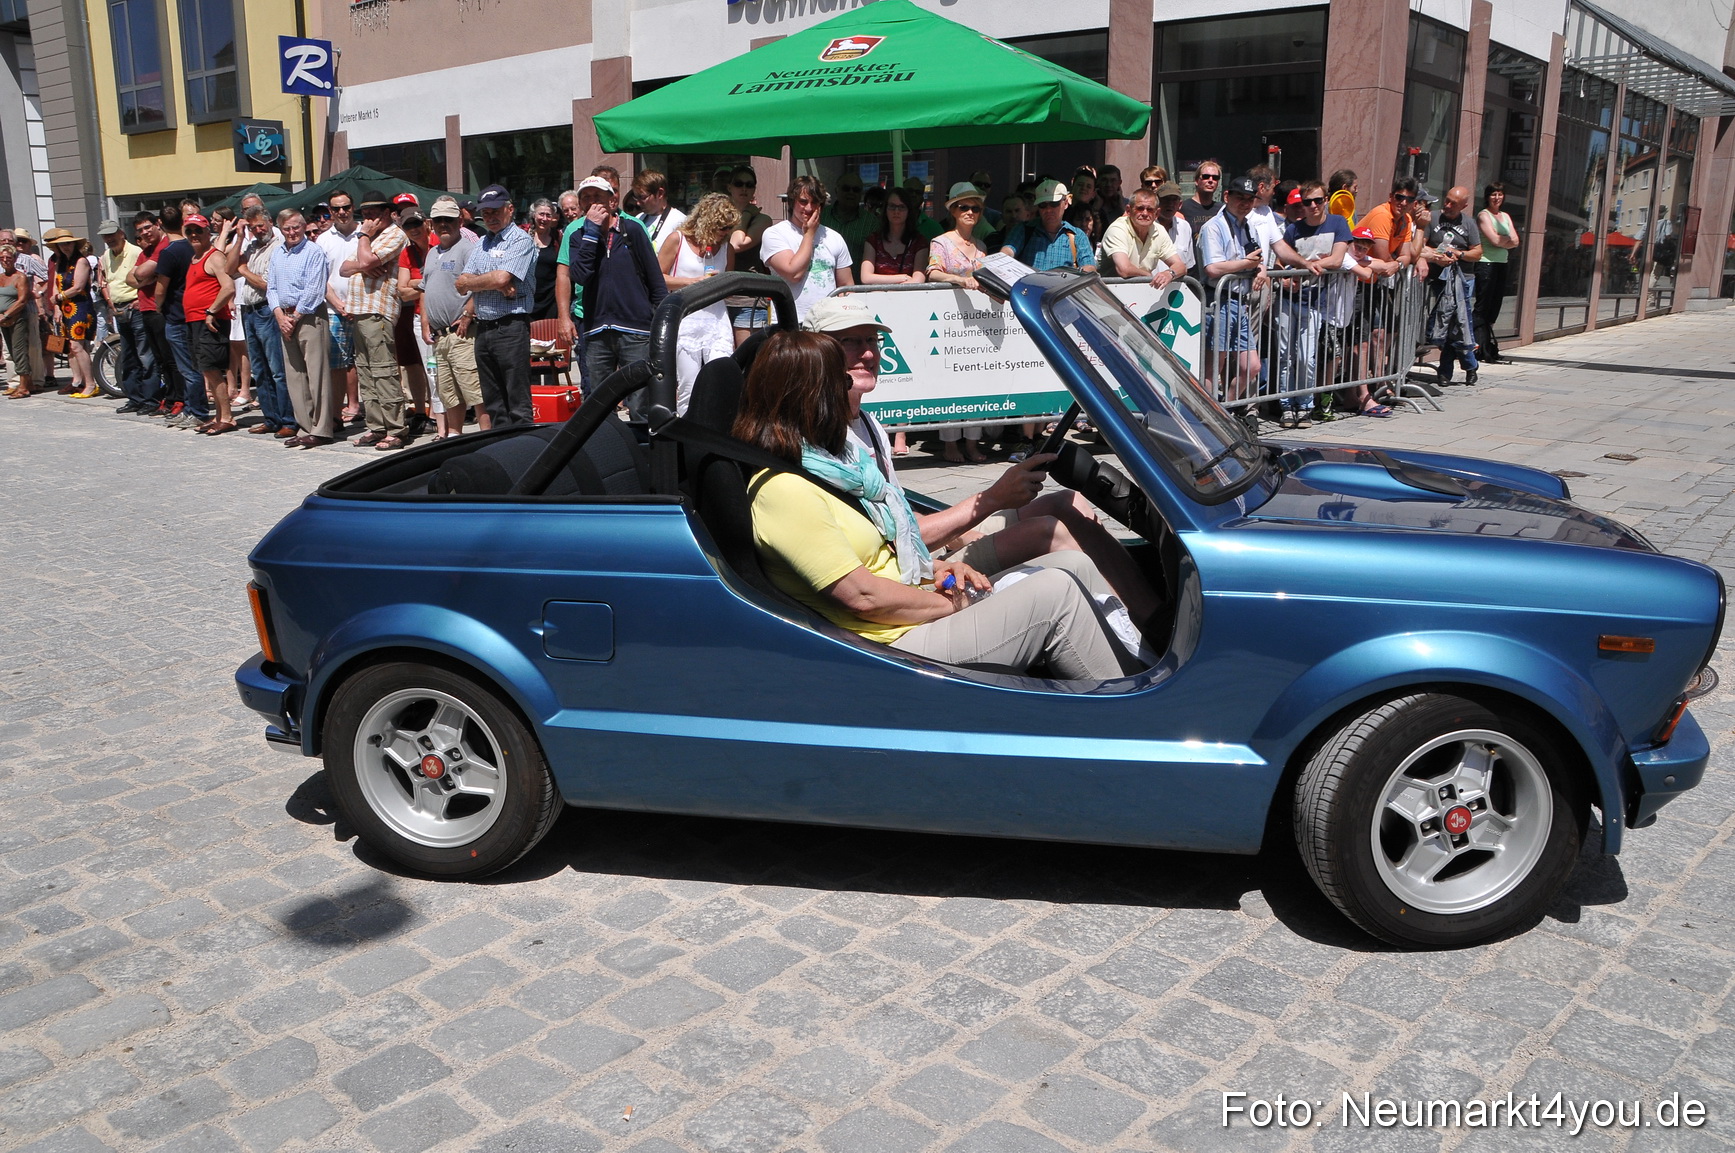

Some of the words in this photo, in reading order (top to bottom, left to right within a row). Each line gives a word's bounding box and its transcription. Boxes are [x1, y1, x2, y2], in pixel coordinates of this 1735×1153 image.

[765, 62, 900, 80] Neumarkter
[728, 71, 916, 95] Lammsbräu
[340, 114, 358, 123] Unterer
[358, 110, 373, 120] Markt
[373, 108, 380, 118] 15
[255, 134, 272, 155] G2
[944, 327, 1027, 338] Hausmeisterdien
[944, 345, 999, 355] Mietservice
[953, 360, 1045, 372] Event-Leit-Systeme
